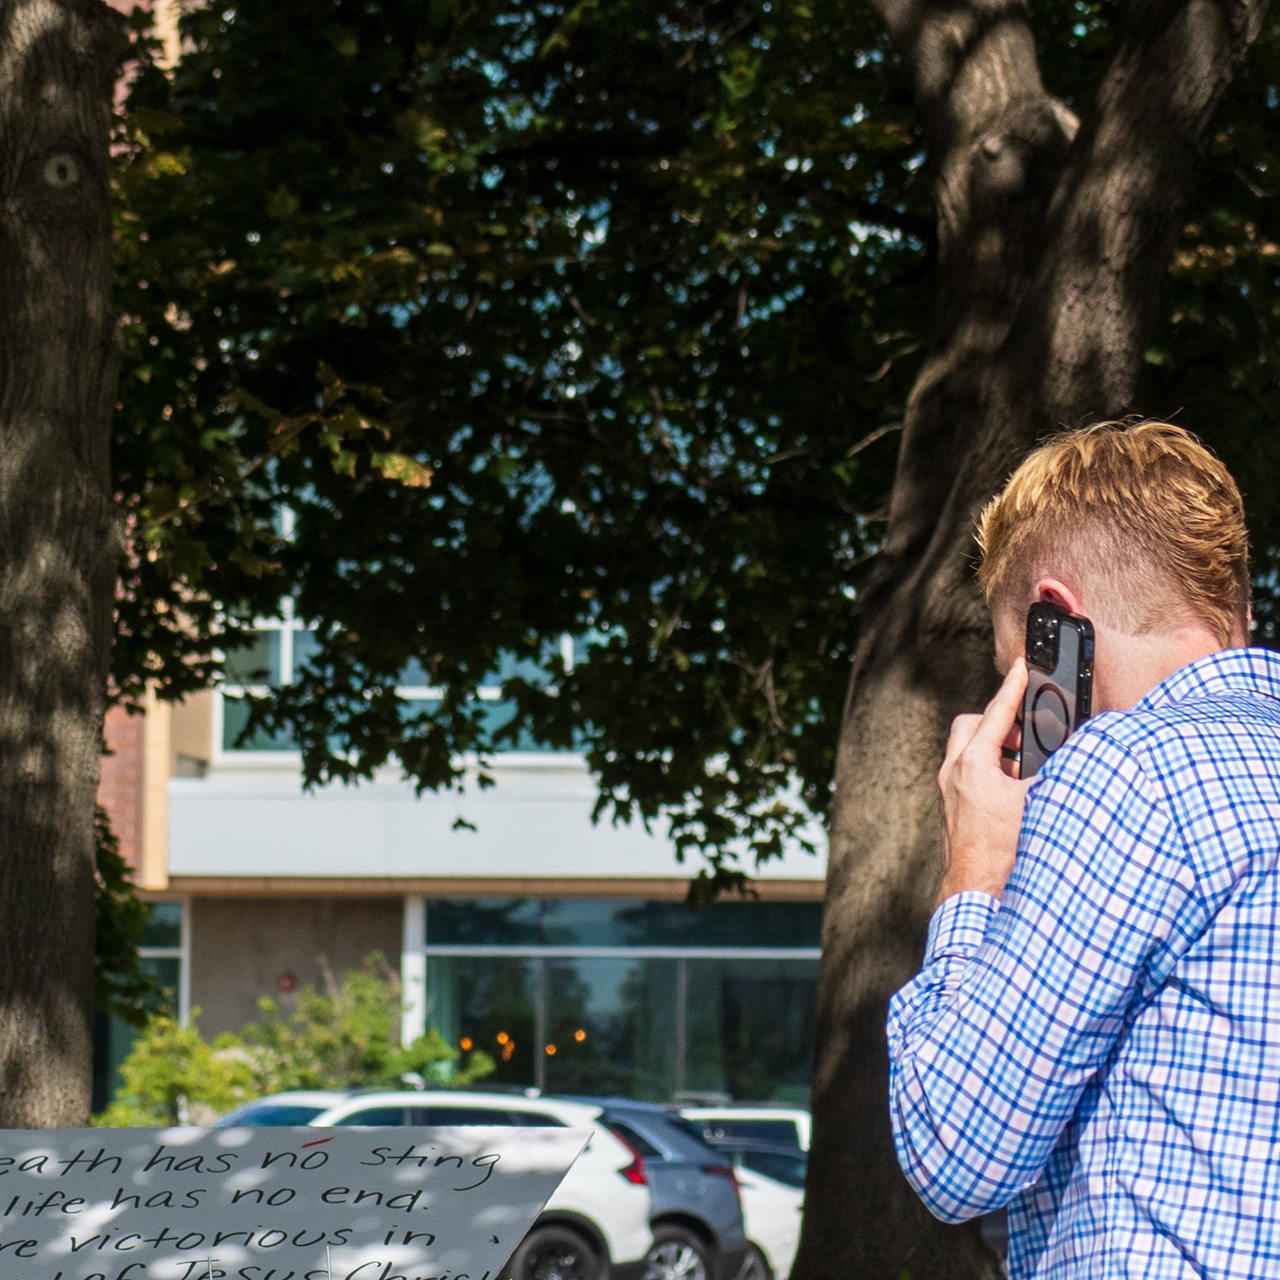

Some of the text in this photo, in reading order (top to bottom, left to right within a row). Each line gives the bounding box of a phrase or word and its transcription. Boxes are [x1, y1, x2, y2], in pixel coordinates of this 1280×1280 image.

[143, 1145, 238, 1174] has
[261, 1146, 329, 1172] no
[362, 1145, 501, 1191] sting
[3, 1186, 87, 1217] life
[110, 1187, 206, 1210] has
[231, 1186, 297, 1207] no
[323, 1184, 427, 1213] end.
[70, 1224, 354, 1251] victorious
[384, 1225, 436, 1248] in
